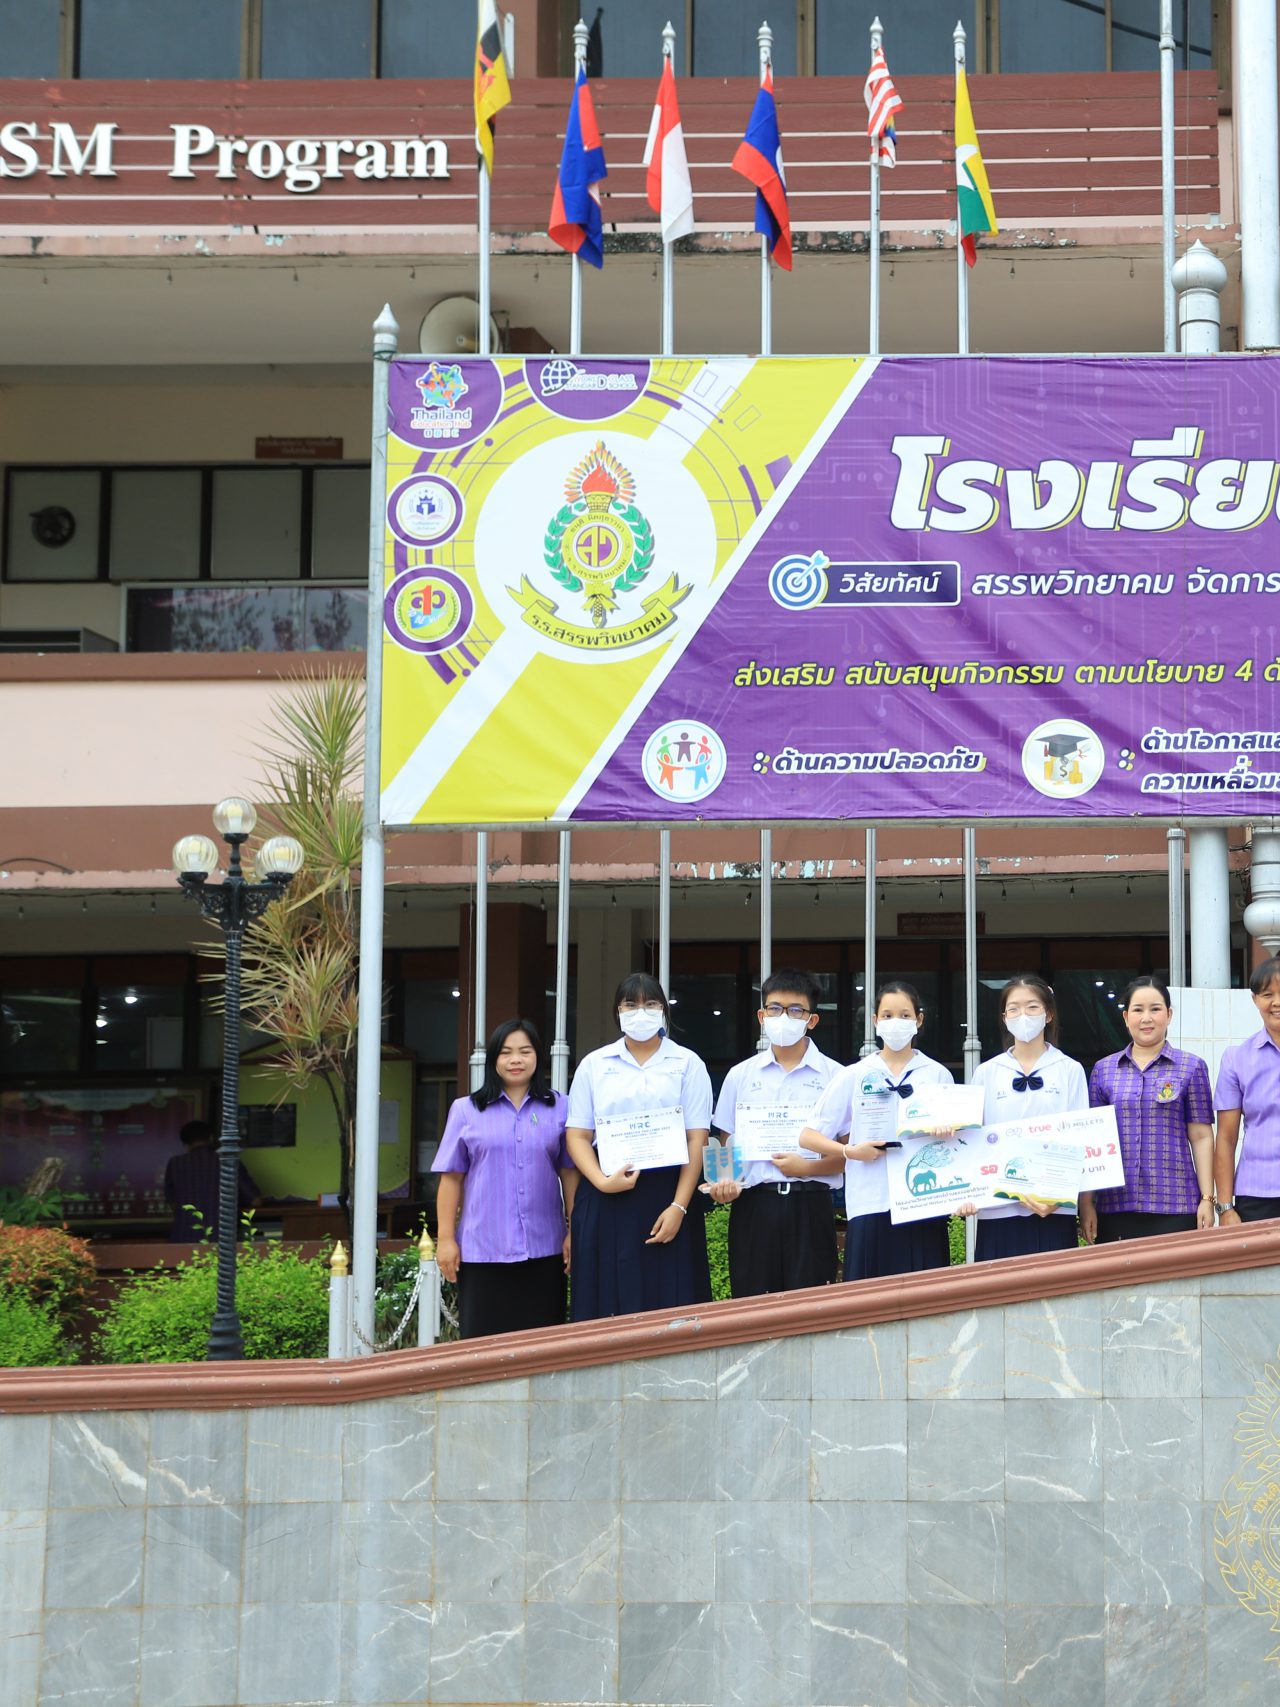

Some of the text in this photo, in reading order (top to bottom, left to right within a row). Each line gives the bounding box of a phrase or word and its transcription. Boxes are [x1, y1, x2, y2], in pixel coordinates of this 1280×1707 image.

[0, 121, 450, 193] SM Program
[412, 407, 471, 421] Thailand
[838, 568, 944, 594] วิสัยทัศน์
[971, 567, 1174, 596] สรรพวิทยาคม
[532, 610, 669, 647] ร.ร.สรรพวิทยาคม
[733, 660, 835, 687] ส่งเสริม
[845, 660, 1064, 692] สนับสนุนกิจกรรม
[1074, 658, 1225, 686] ตามนโยบาย
[1234, 659, 1253, 683] 4
[773, 747, 981, 774] ด้านความปลอดภัย
[1029, 1123, 1052, 1133] true
[1106, 1143, 1117, 1155] 2
